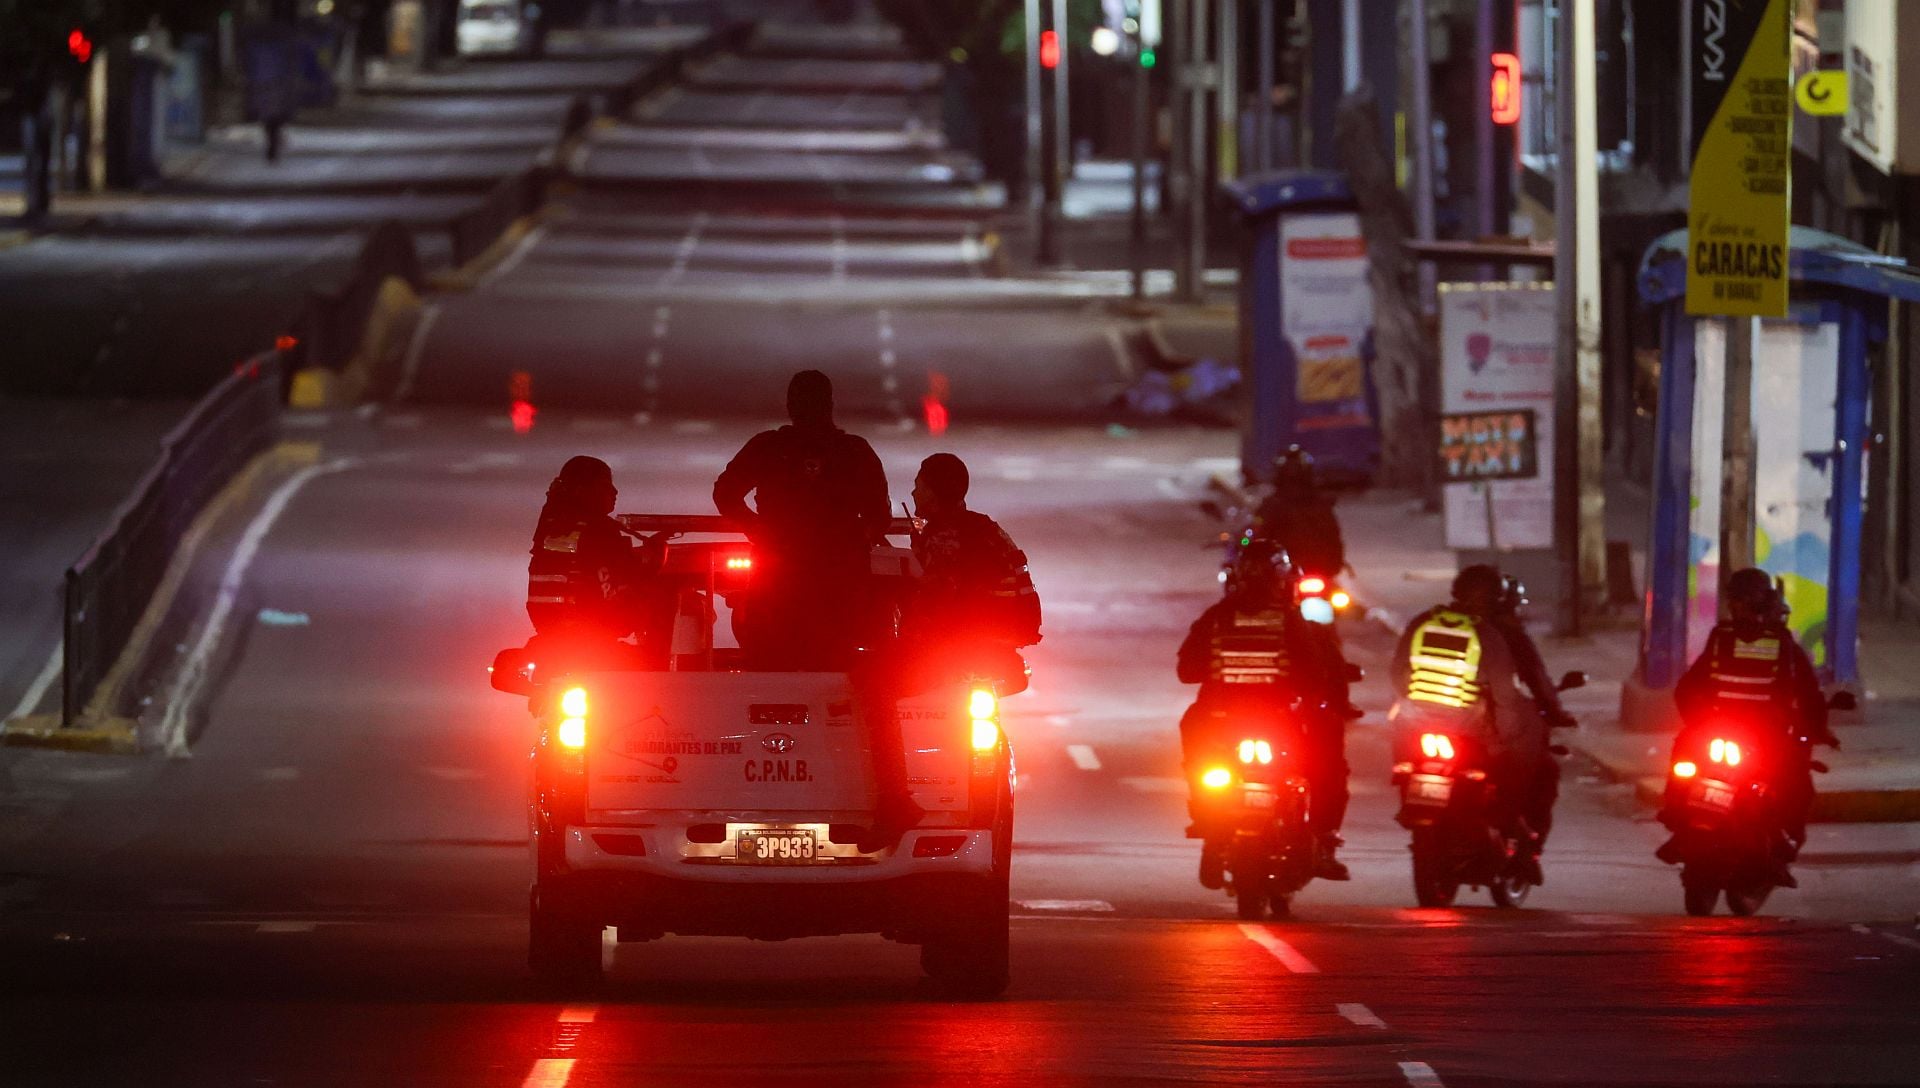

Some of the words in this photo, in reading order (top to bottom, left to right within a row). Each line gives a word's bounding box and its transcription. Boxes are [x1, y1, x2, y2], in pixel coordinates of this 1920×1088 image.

[1696, 240, 1782, 280] CARACAS
[1442, 413, 1527, 445] MOTO
[1439, 442, 1521, 476] TAXI
[625, 741, 702, 755] CUADRANTES
[703, 741, 719, 755] DE
[721, 741, 743, 755] PAZ
[744, 758, 813, 783] C.P.N.B.
[756, 836, 814, 859] 3P933
